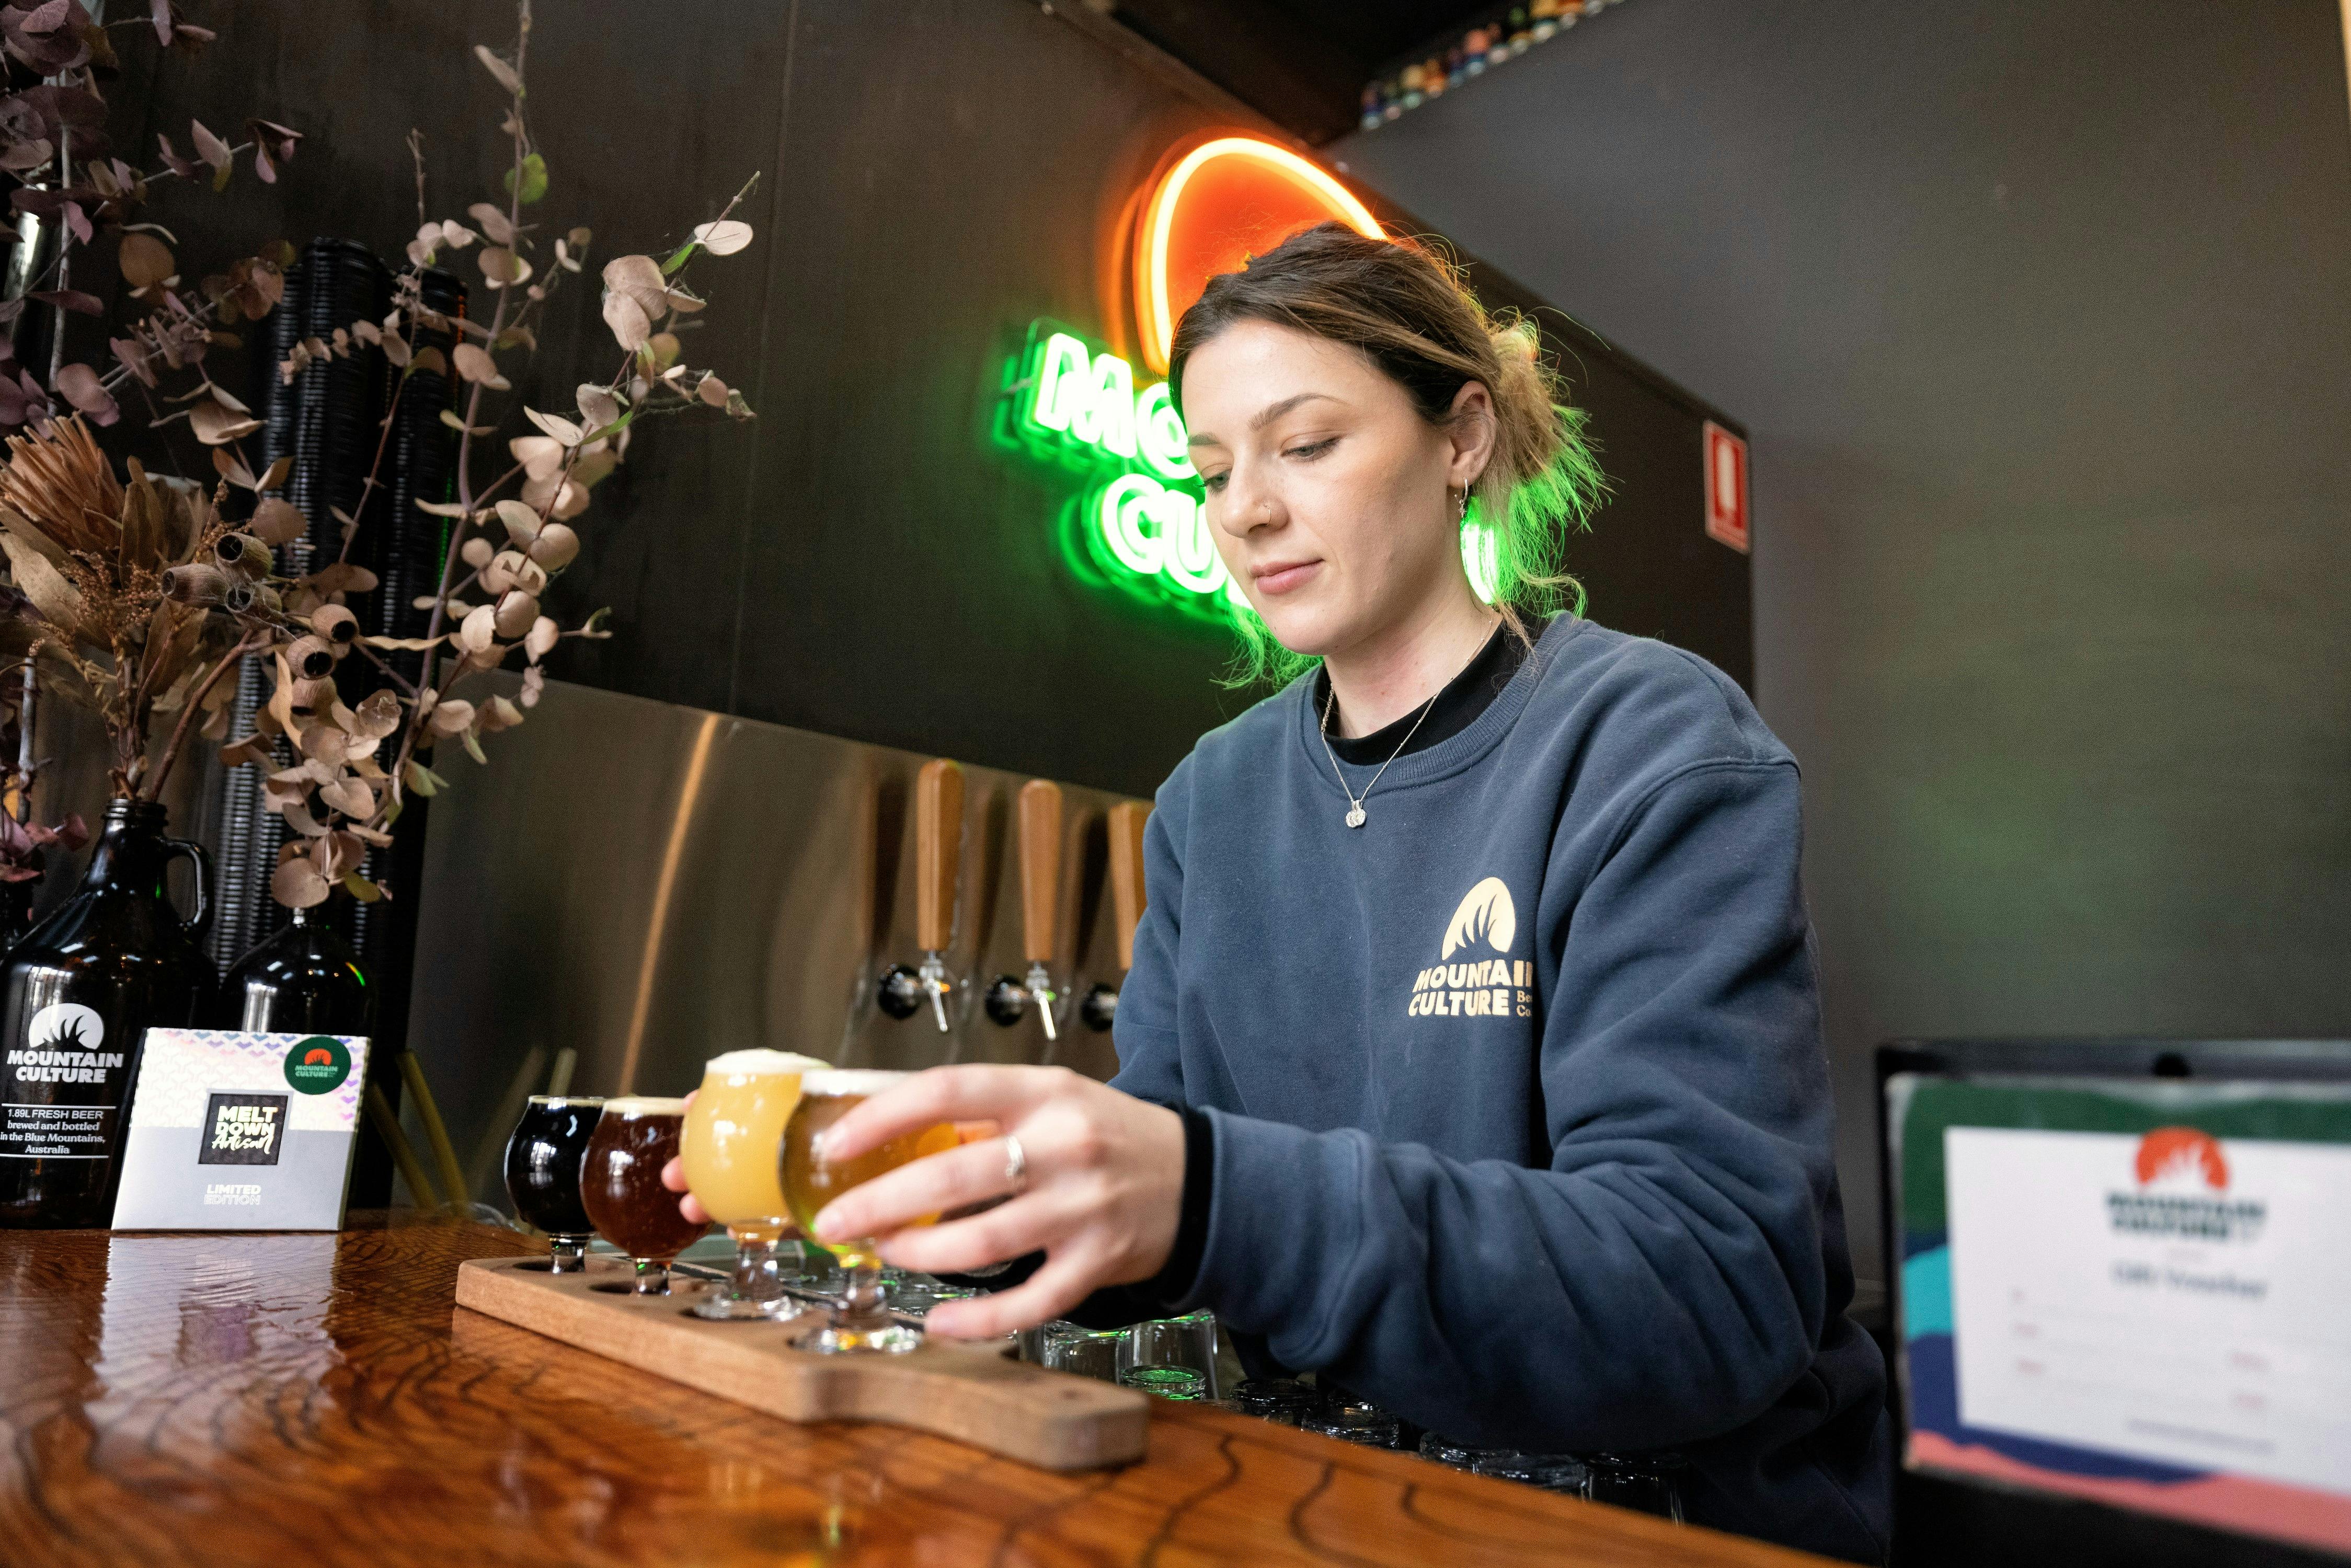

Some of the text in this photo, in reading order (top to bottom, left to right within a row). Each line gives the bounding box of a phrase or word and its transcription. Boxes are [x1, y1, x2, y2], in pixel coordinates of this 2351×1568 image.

[1408, 989, 1509, 1016] CULTURE
[7, 1050, 124, 1068] MOUNTAIN
[16, 1067, 107, 1083] CULTURE
[8, 1109, 104, 1120] 1.89L FRESH BEER
[217, 1105, 279, 1123] MELT
[7, 1120, 100, 1131] brewed and bottled
[215, 1122, 276, 1136] DOWN
[0, 1132, 106, 1144] in the Blue Mountains,
[212, 1133, 274, 1155] Artisan
[25, 1145, 71, 1155] Australia
[207, 1184, 261, 1194] LIMITED
[204, 1194, 261, 1205] EDITION
